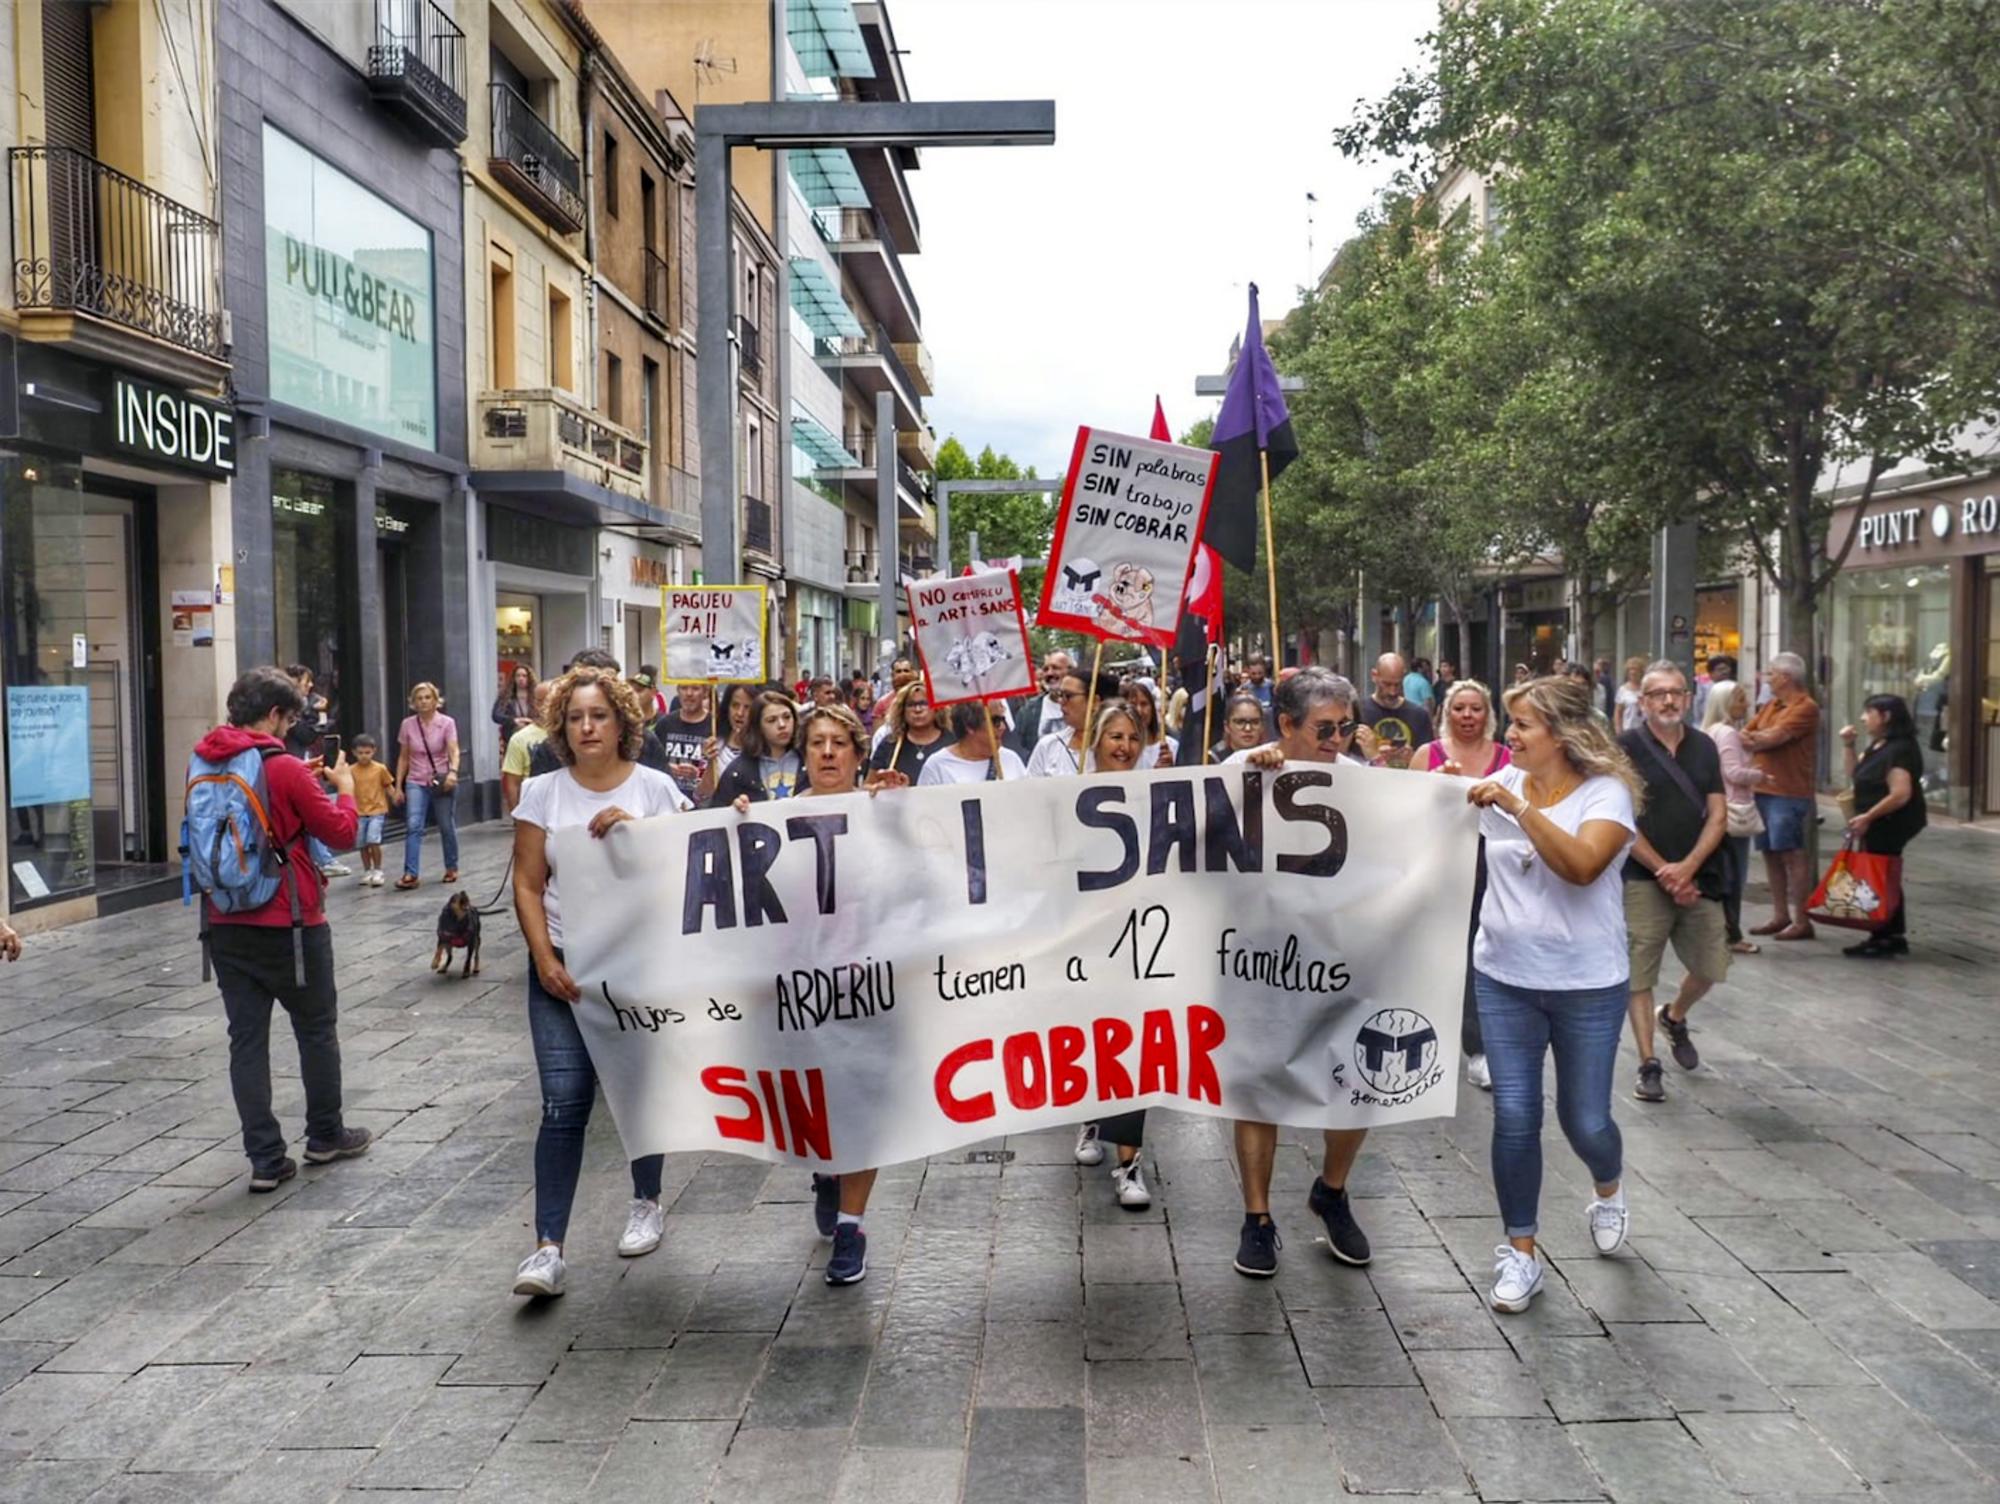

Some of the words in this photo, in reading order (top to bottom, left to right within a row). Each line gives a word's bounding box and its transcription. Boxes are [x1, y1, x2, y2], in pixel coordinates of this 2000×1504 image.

[116, 380, 234, 470] INSIDE
[1091, 444, 1132, 469] SIN
[1135, 458, 1206, 487] palabras
[1083, 472, 1120, 497] SIN
[1126, 484, 1193, 520] trabajo
[1075, 504, 1110, 527] SIN
[1114, 511, 1188, 543] COBRAR
[1859, 508, 1920, 548] PUNT
[672, 592, 733, 609] PAGUEU
[919, 587, 946, 607] NO
[938, 605, 967, 623] ART
[980, 599, 1017, 616] SANS
[682, 813, 849, 935] ART
[961, 798, 987, 905] I
[1075, 770, 1348, 892] SANS
[602, 981, 686, 1033] hijos
[707, 998, 742, 1021] de
[933, 955, 1026, 1002] tienen
[1067, 955, 1088, 982] a
[1108, 904, 1175, 980] 12
[700, 1065, 833, 1161] SIN
[934, 1004, 1227, 1124] COBRAR
